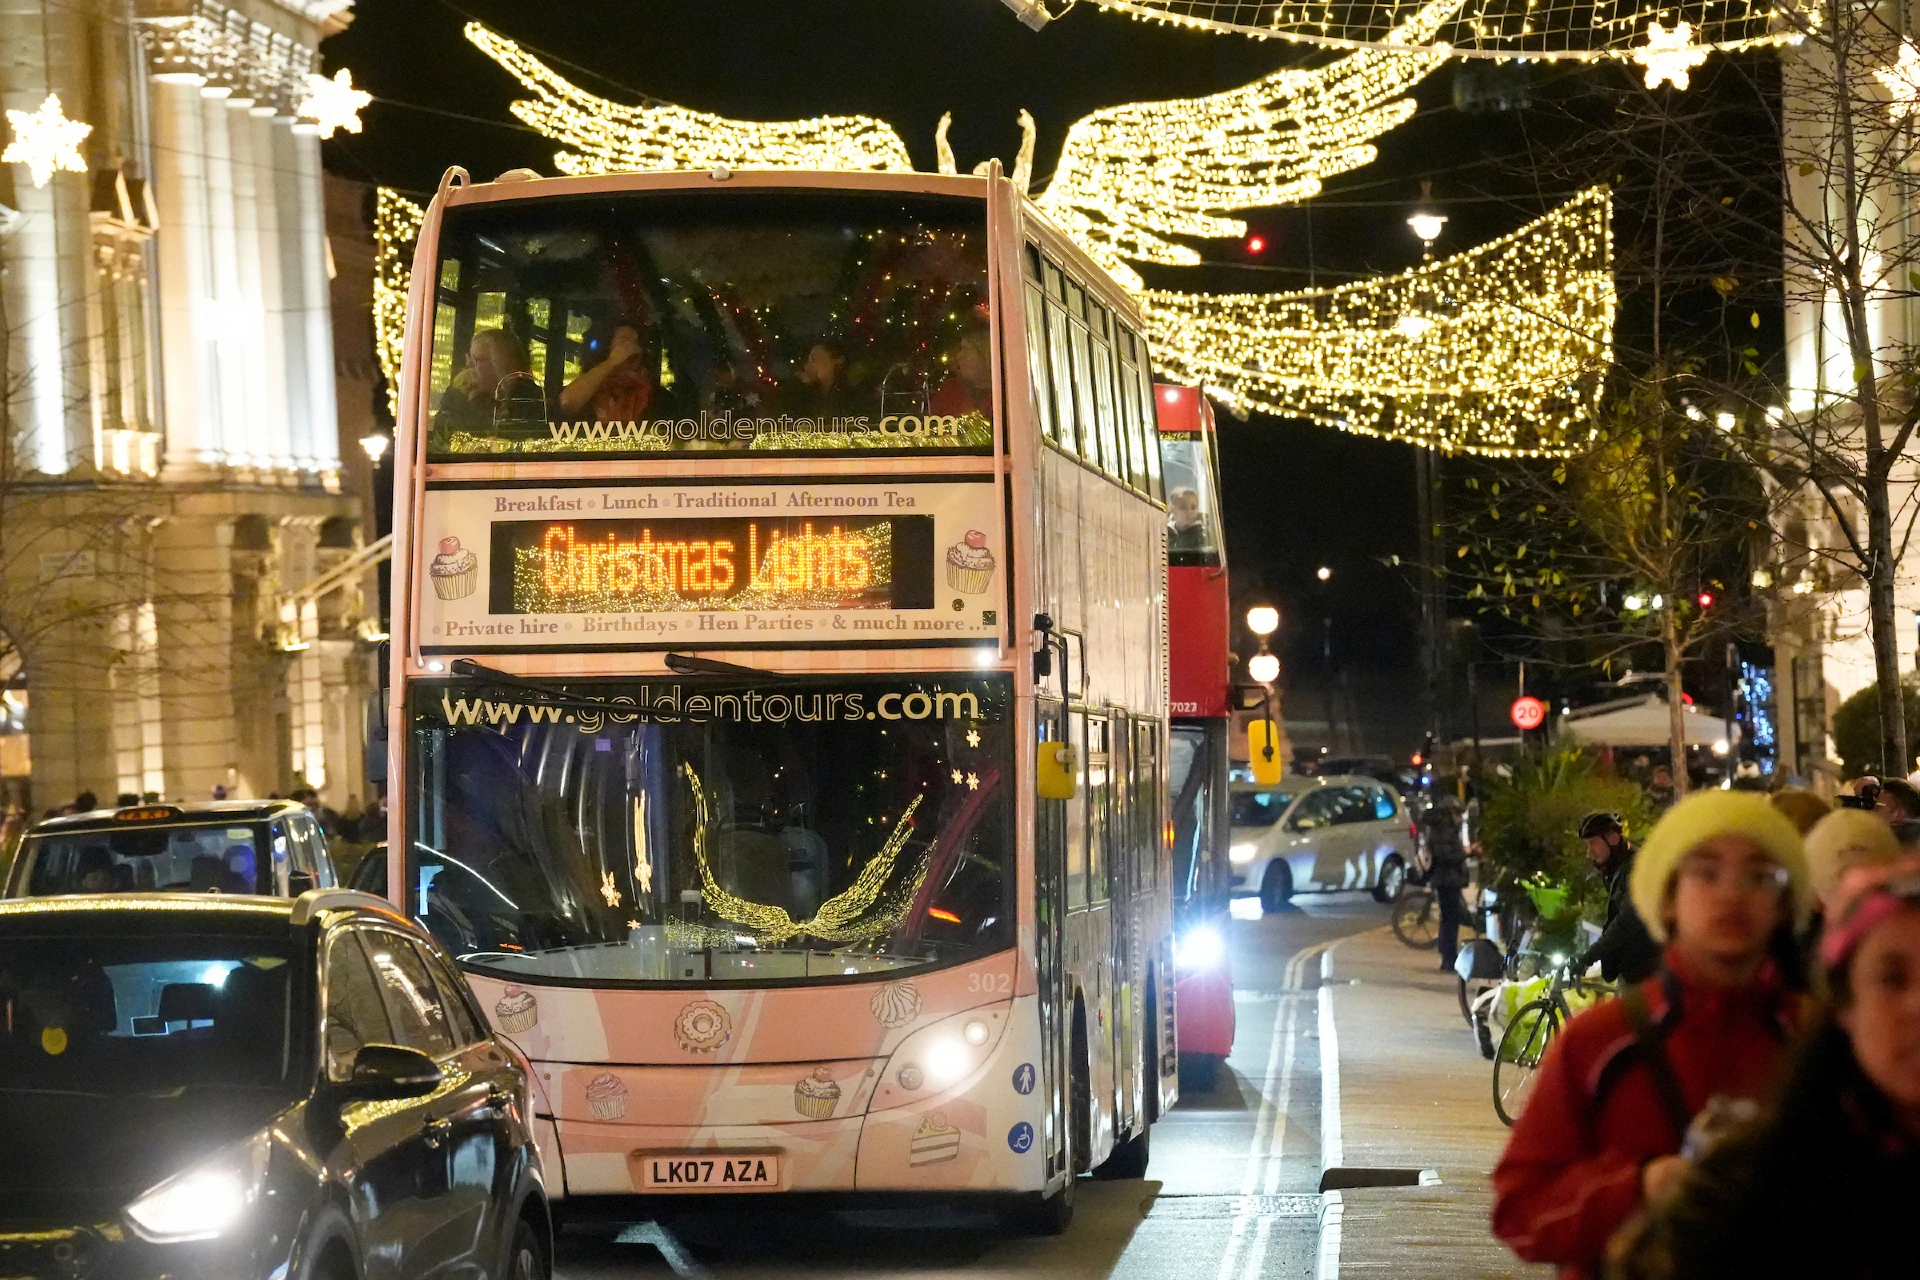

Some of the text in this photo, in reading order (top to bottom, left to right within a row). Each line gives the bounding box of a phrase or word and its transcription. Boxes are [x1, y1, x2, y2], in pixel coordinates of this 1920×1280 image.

[548, 409, 958, 445] www.goldentours.com
[494, 490, 916, 513] Breakfast Lunch Traditional Afternoon Tea
[543, 521, 870, 594] Christmas Lights
[445, 620, 515, 637] Private
[520, 618, 559, 635] hire
[582, 615, 678, 636] Birthdays
[698, 614, 739, 631] Hen
[744, 613, 813, 631] Parties
[832, 614, 848, 630] &
[853, 614, 908, 631] much
[441, 685, 980, 736] www.goldentours.com
[1517, 706, 1539, 719] 20
[967, 972, 1011, 993] 302
[653, 1160, 768, 1183] LK07 AZA
